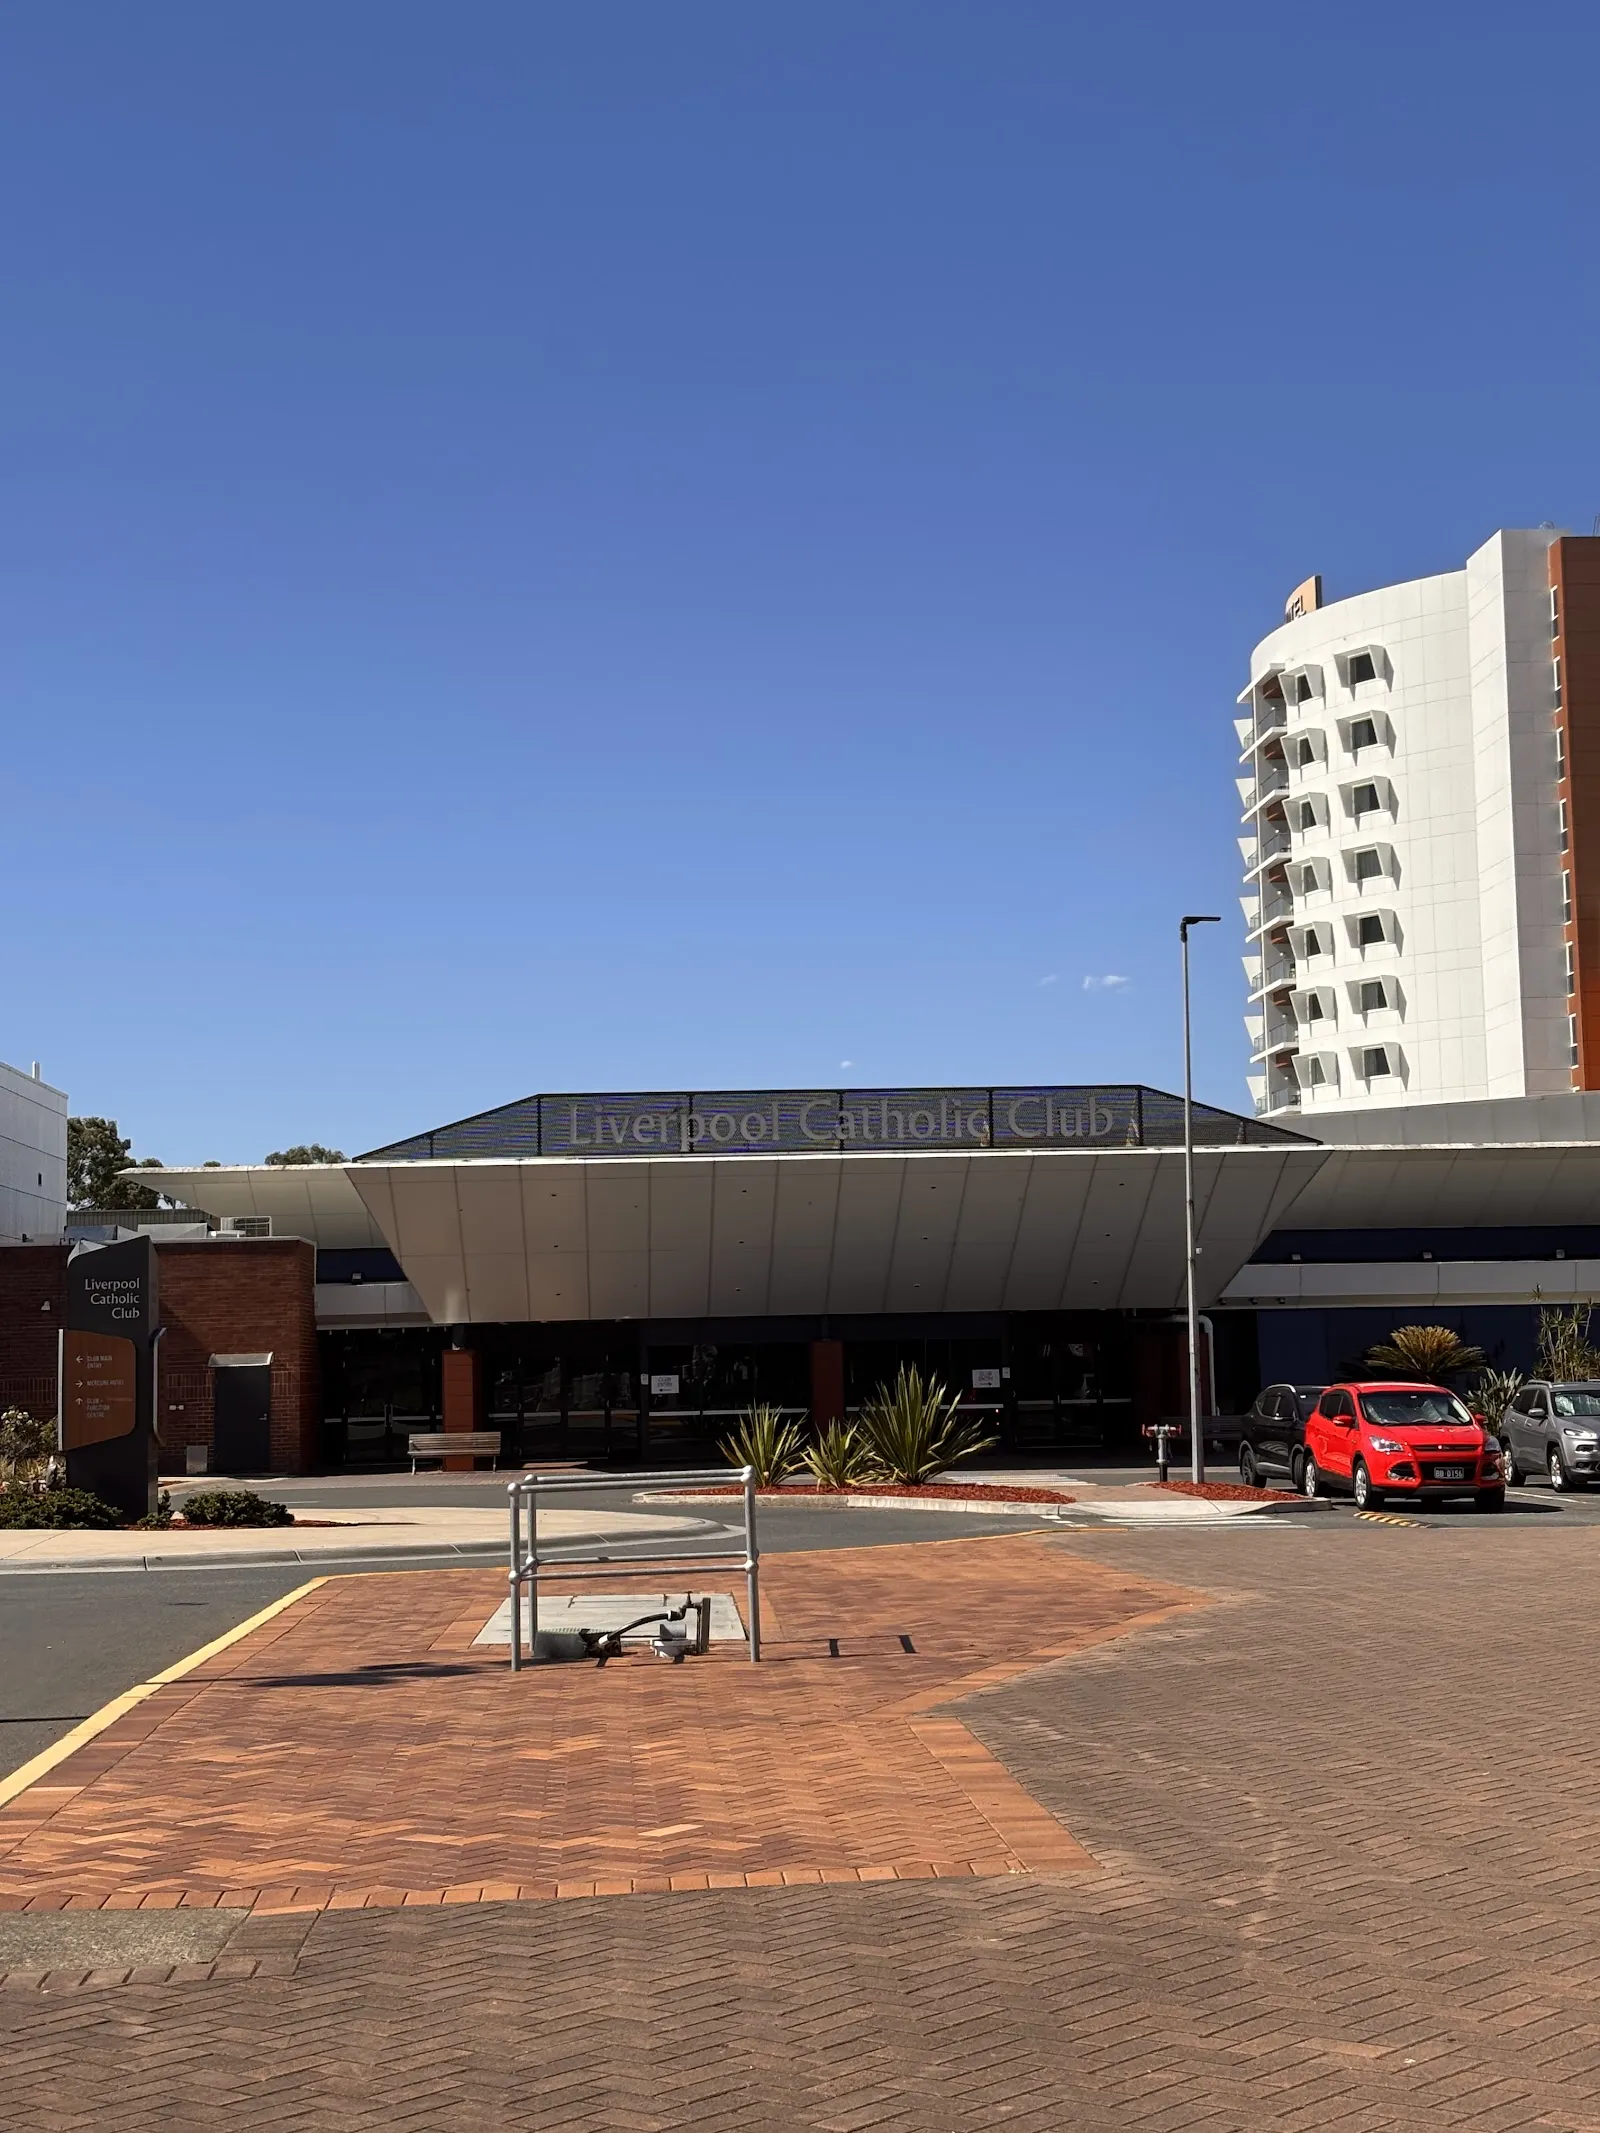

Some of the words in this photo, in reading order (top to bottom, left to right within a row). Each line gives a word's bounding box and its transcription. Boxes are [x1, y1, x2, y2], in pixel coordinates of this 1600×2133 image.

[568, 1099, 780, 1152] Liverpool
[799, 1097, 989, 1142] Catholic
[1007, 1095, 1115, 1139] Club
[84, 1277, 140, 1291] Liverpool
[90, 1292, 140, 1305] Catholic
[111, 1307, 140, 1319] Club
